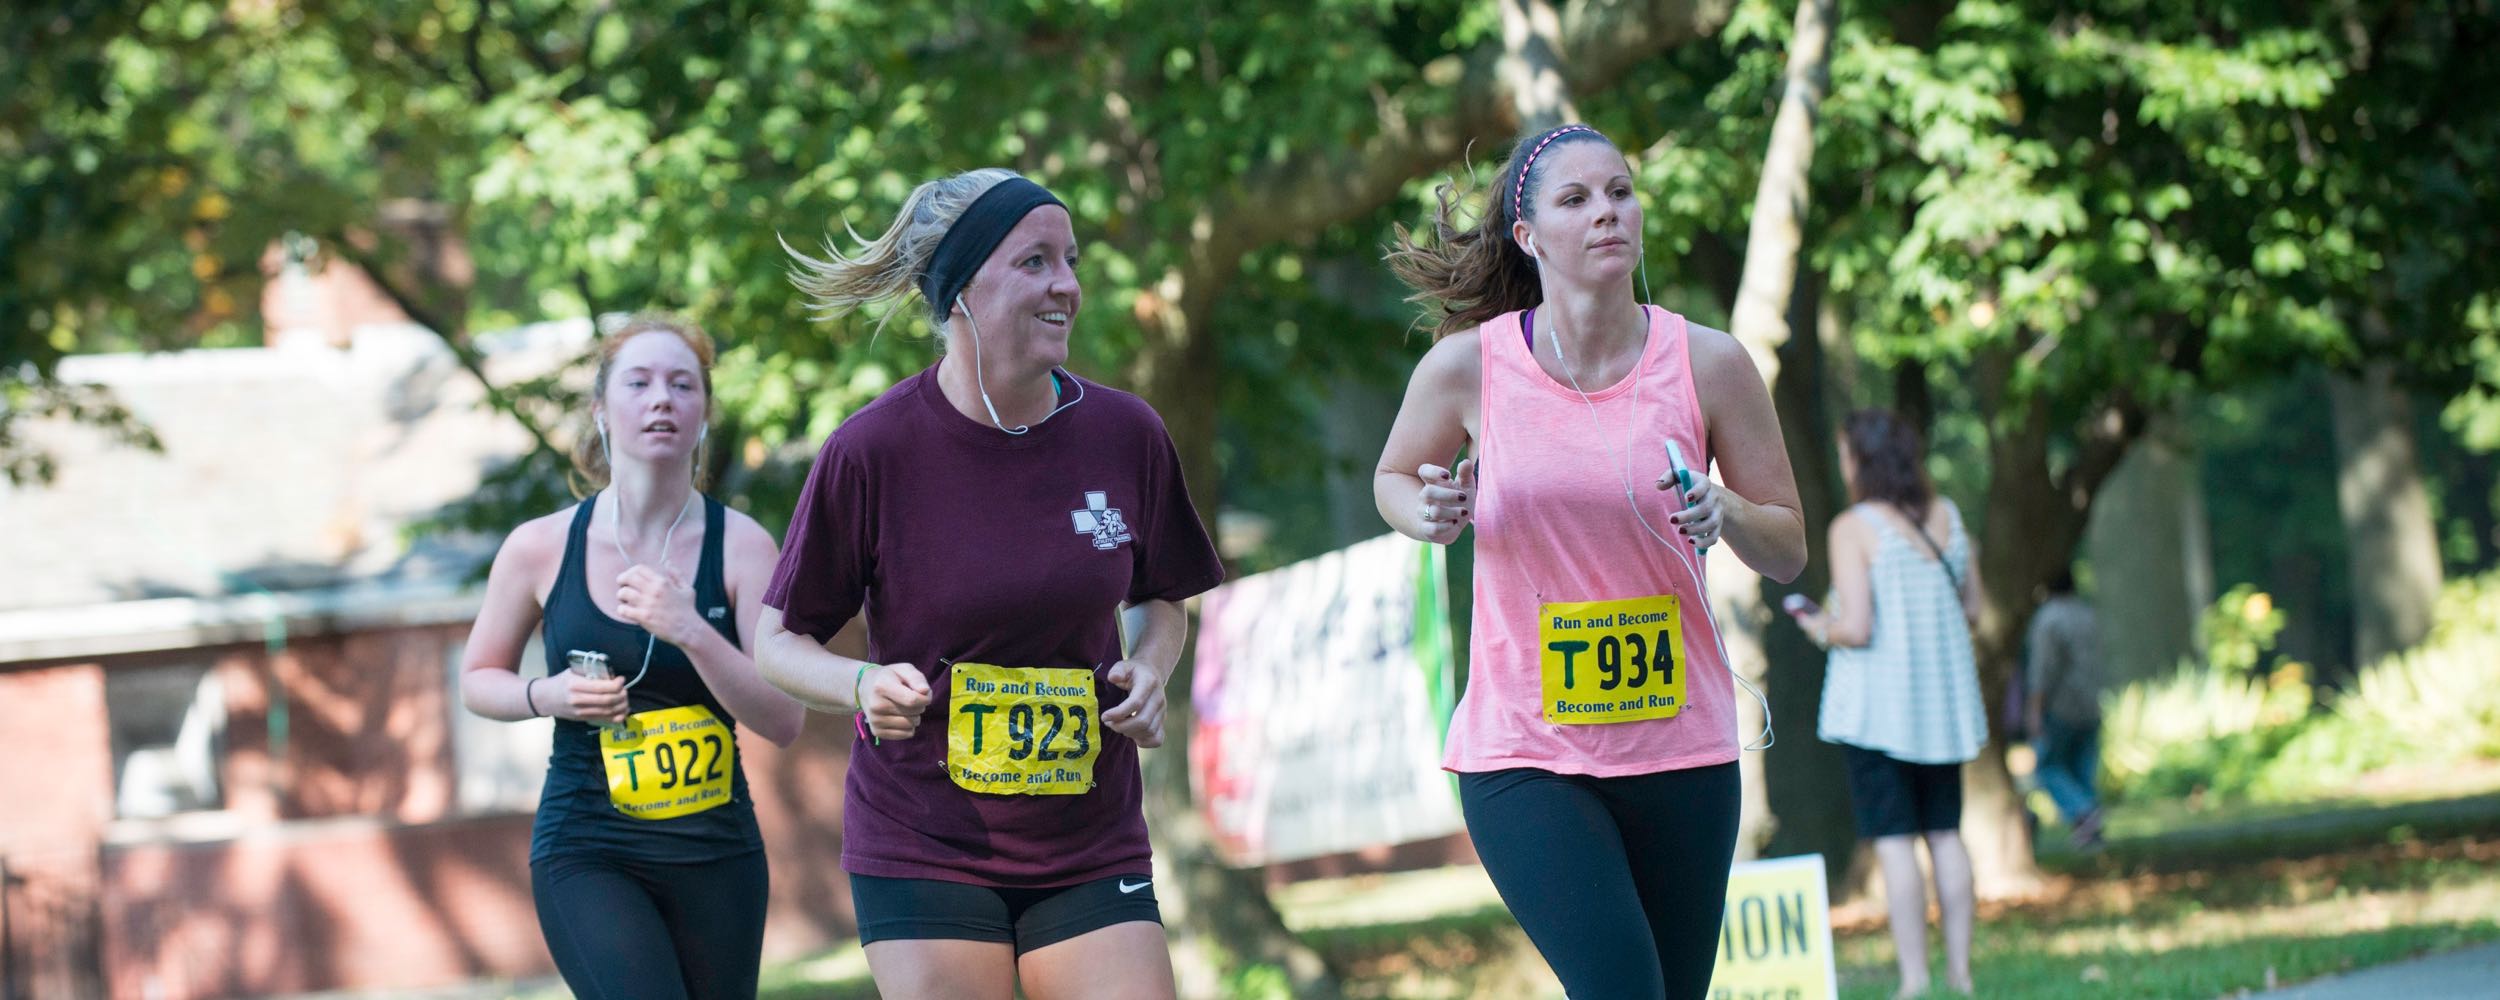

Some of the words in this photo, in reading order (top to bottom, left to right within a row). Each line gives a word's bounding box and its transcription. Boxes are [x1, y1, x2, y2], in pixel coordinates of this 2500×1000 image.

[1553, 617, 1581, 630] Run
[1587, 614, 1613, 628] and
[1618, 611, 1668, 627] Become
[1548, 640, 1590, 690] T
[1597, 629, 1674, 691] 934
[966, 677, 996, 693] Run
[1001, 681, 1029, 695] and
[1035, 682, 1087, 697] Become
[1557, 700, 1614, 713] Become
[1619, 696, 1644, 711] and
[1648, 694, 1675, 707] Run
[613, 730, 637, 742] Run
[642, 723, 665, 736] and
[670, 717, 717, 732] Become
[959, 703, 998, 756] T
[1008, 703, 1090, 762] 923
[613, 750, 645, 792] T
[655, 734, 723, 790] 922
[962, 768, 1021, 783] Become
[1026, 770, 1051, 784] and
[1055, 768, 1082, 783] Run
[624, 801, 671, 813] Become
[676, 794, 698, 806] and
[701, 788, 721, 799] Run
